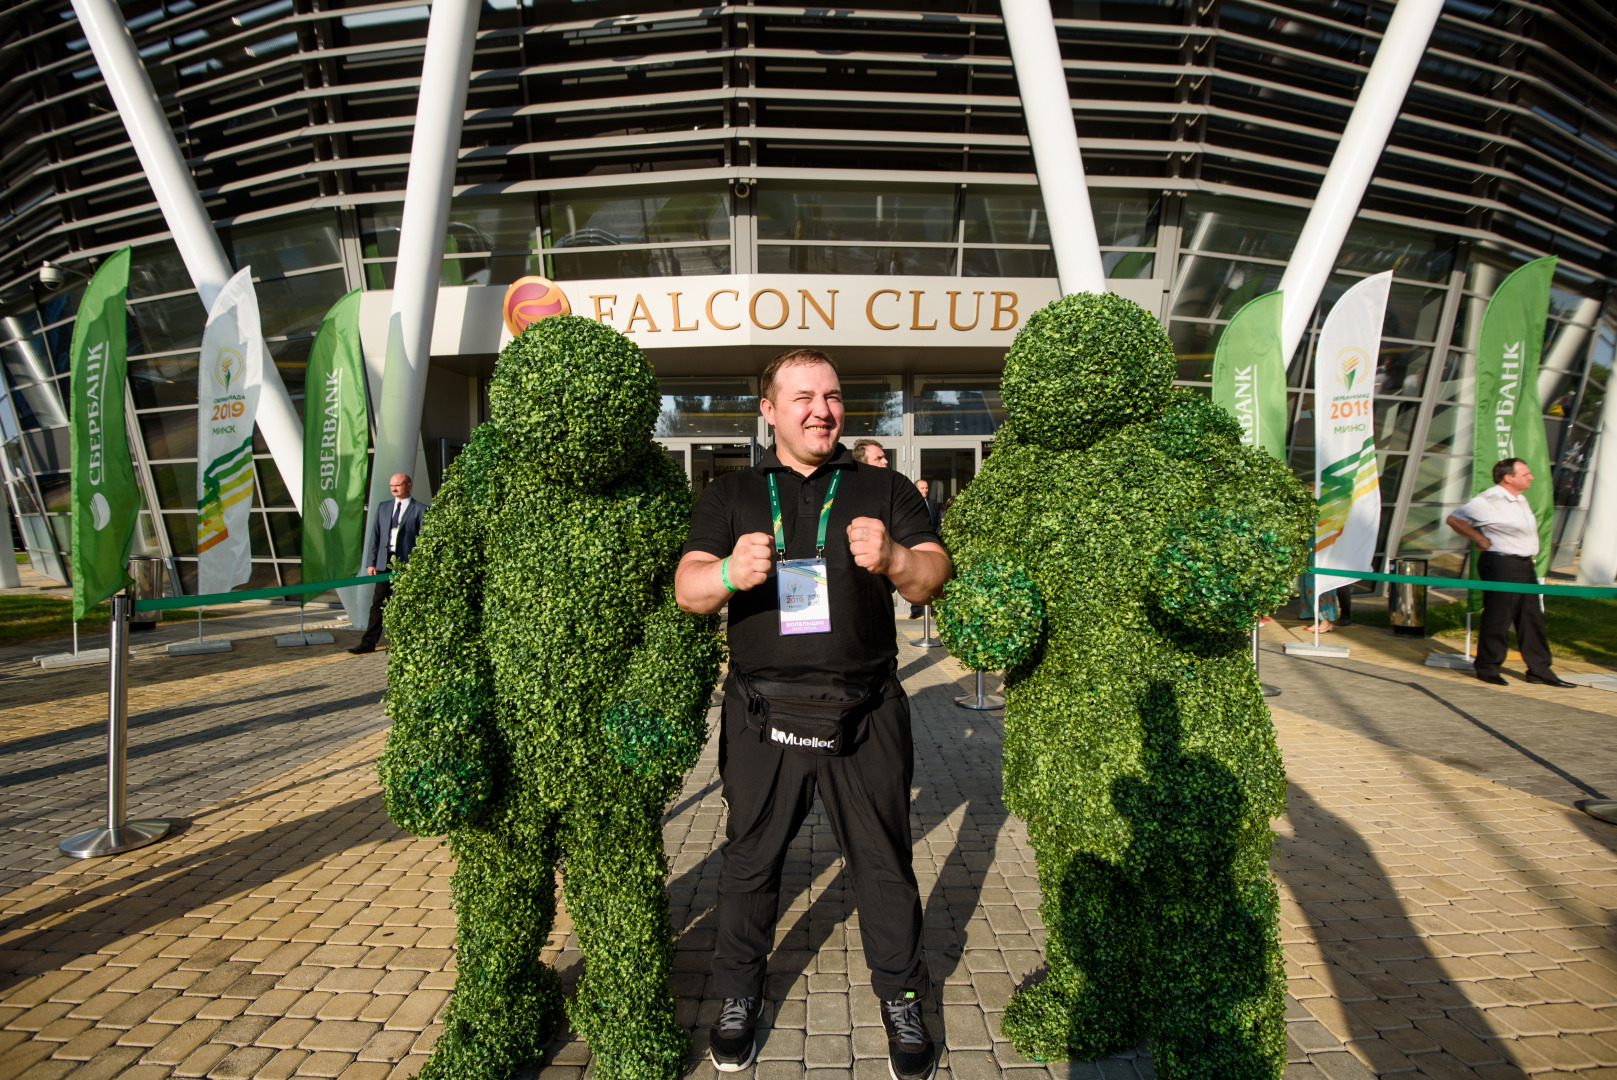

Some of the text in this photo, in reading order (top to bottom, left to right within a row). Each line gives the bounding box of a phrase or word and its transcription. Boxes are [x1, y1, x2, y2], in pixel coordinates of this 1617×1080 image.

[588, 288, 1019, 333] FALCON CLUB
[86, 342, 104, 486] СБЕРБАНК
[211, 401, 245, 421] 2019
[320, 368, 339, 491] SBERBANK
[1234, 365, 1253, 443] RBANK
[1495, 341, 1520, 461] БЕРБАНК
[786, 596, 804, 604] 2019
